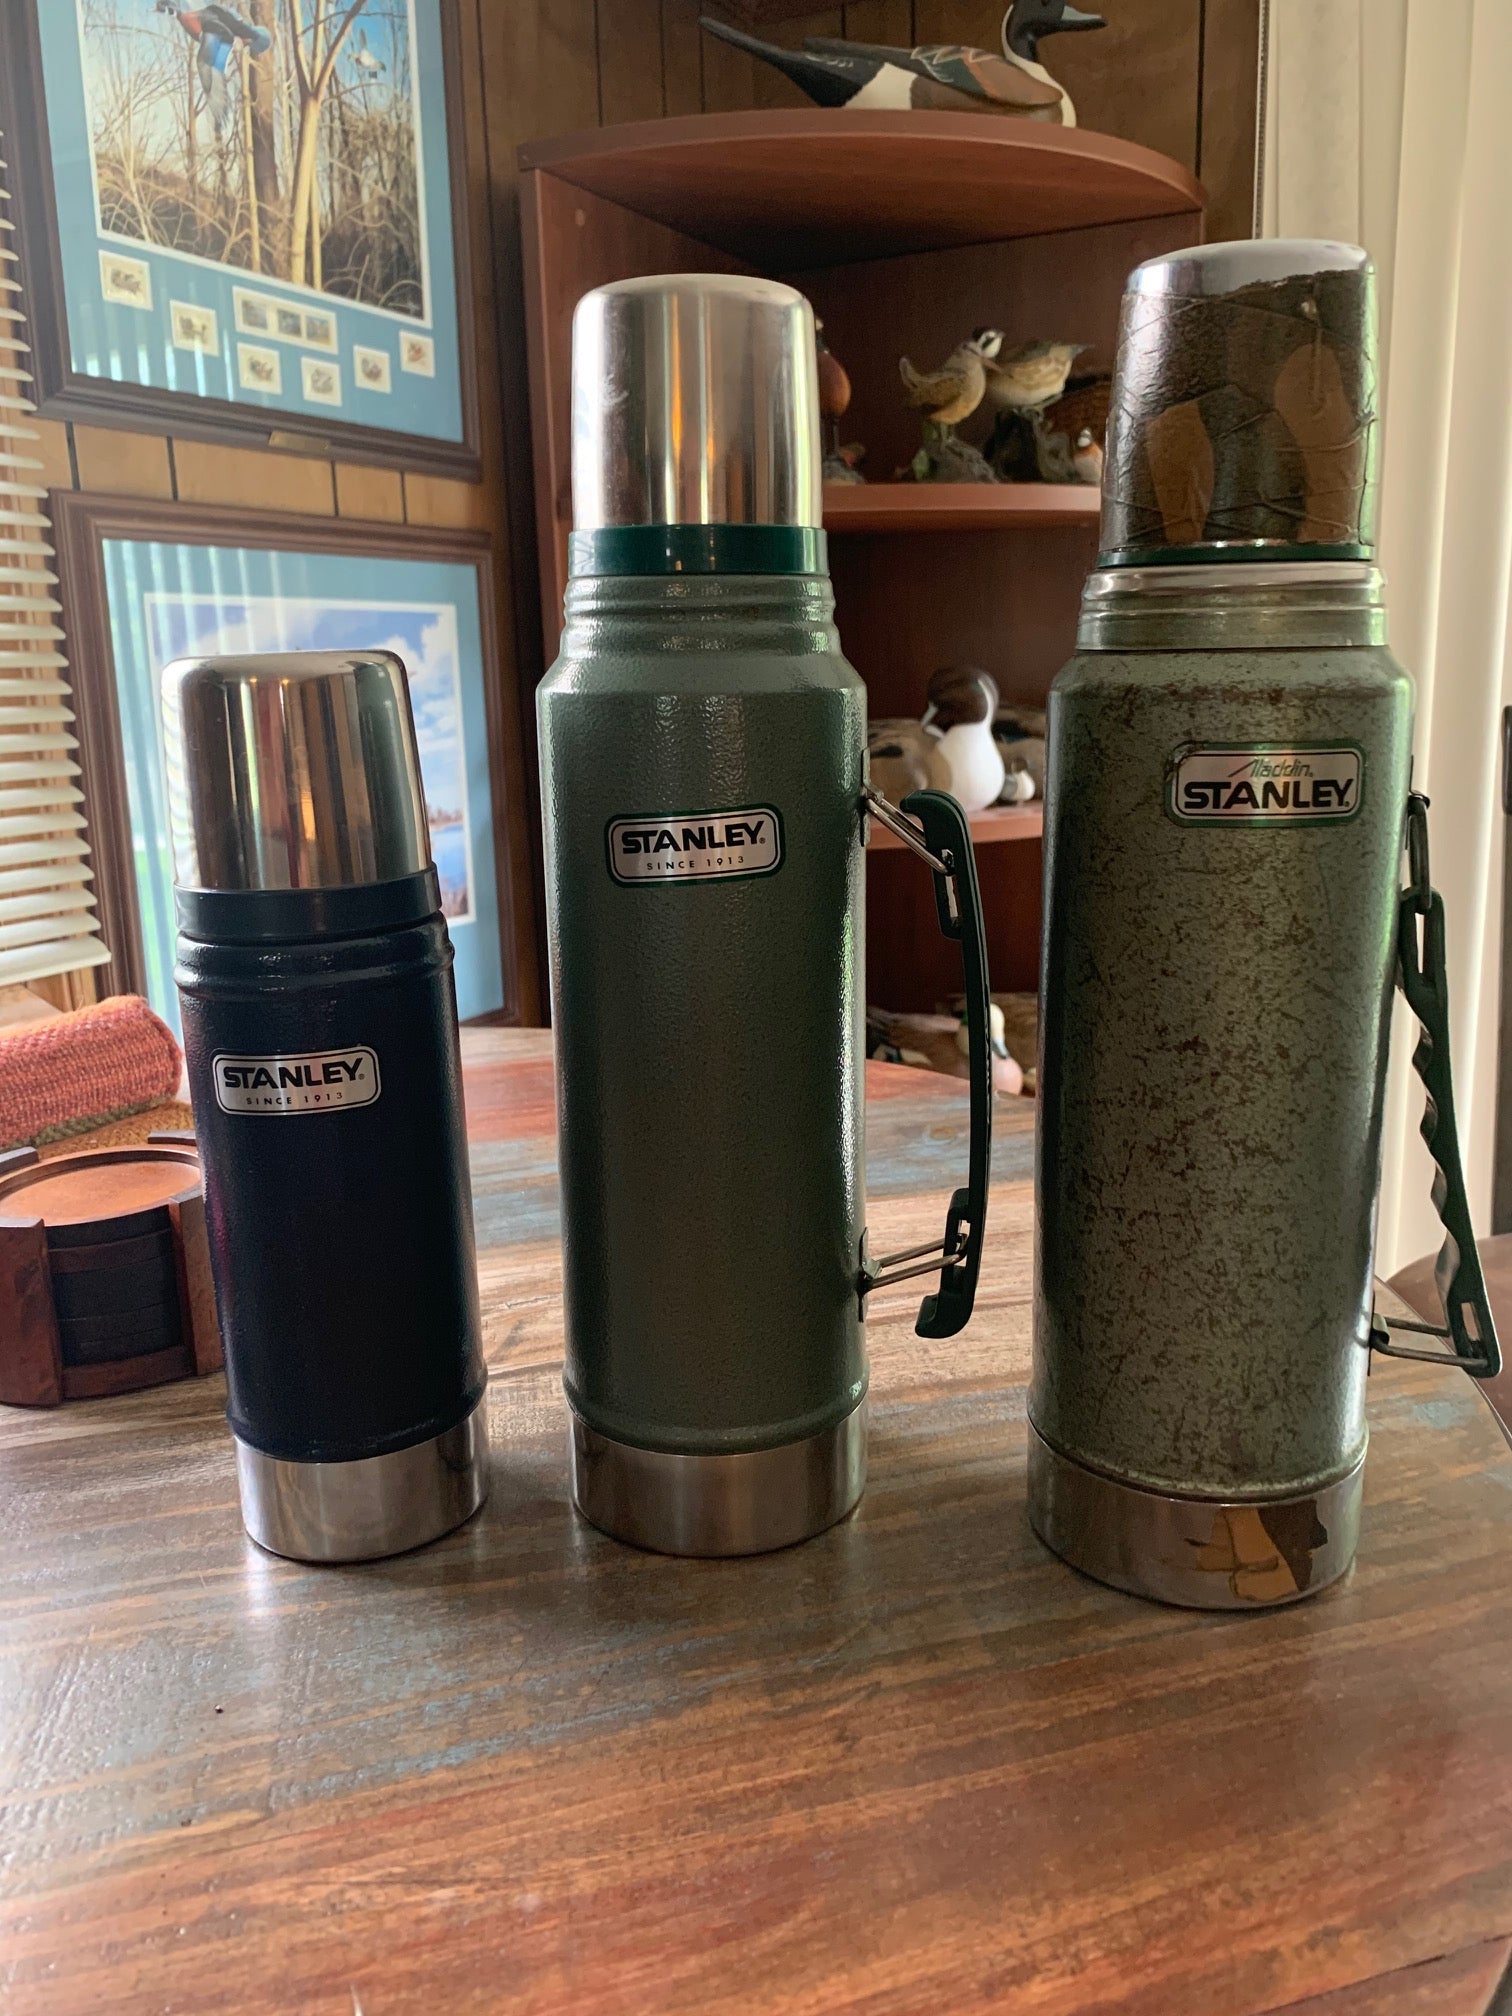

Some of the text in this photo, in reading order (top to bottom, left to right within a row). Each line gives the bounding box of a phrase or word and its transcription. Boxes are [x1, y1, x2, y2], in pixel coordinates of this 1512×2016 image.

[1184, 778, 1354, 810] STANLEY
[621, 820, 765, 854] STANLEY
[646, 856, 745, 871] SINCE 1913
[223, 1057, 364, 1089] STANLEY
[246, 1092, 343, 1105] SINCE 1913
